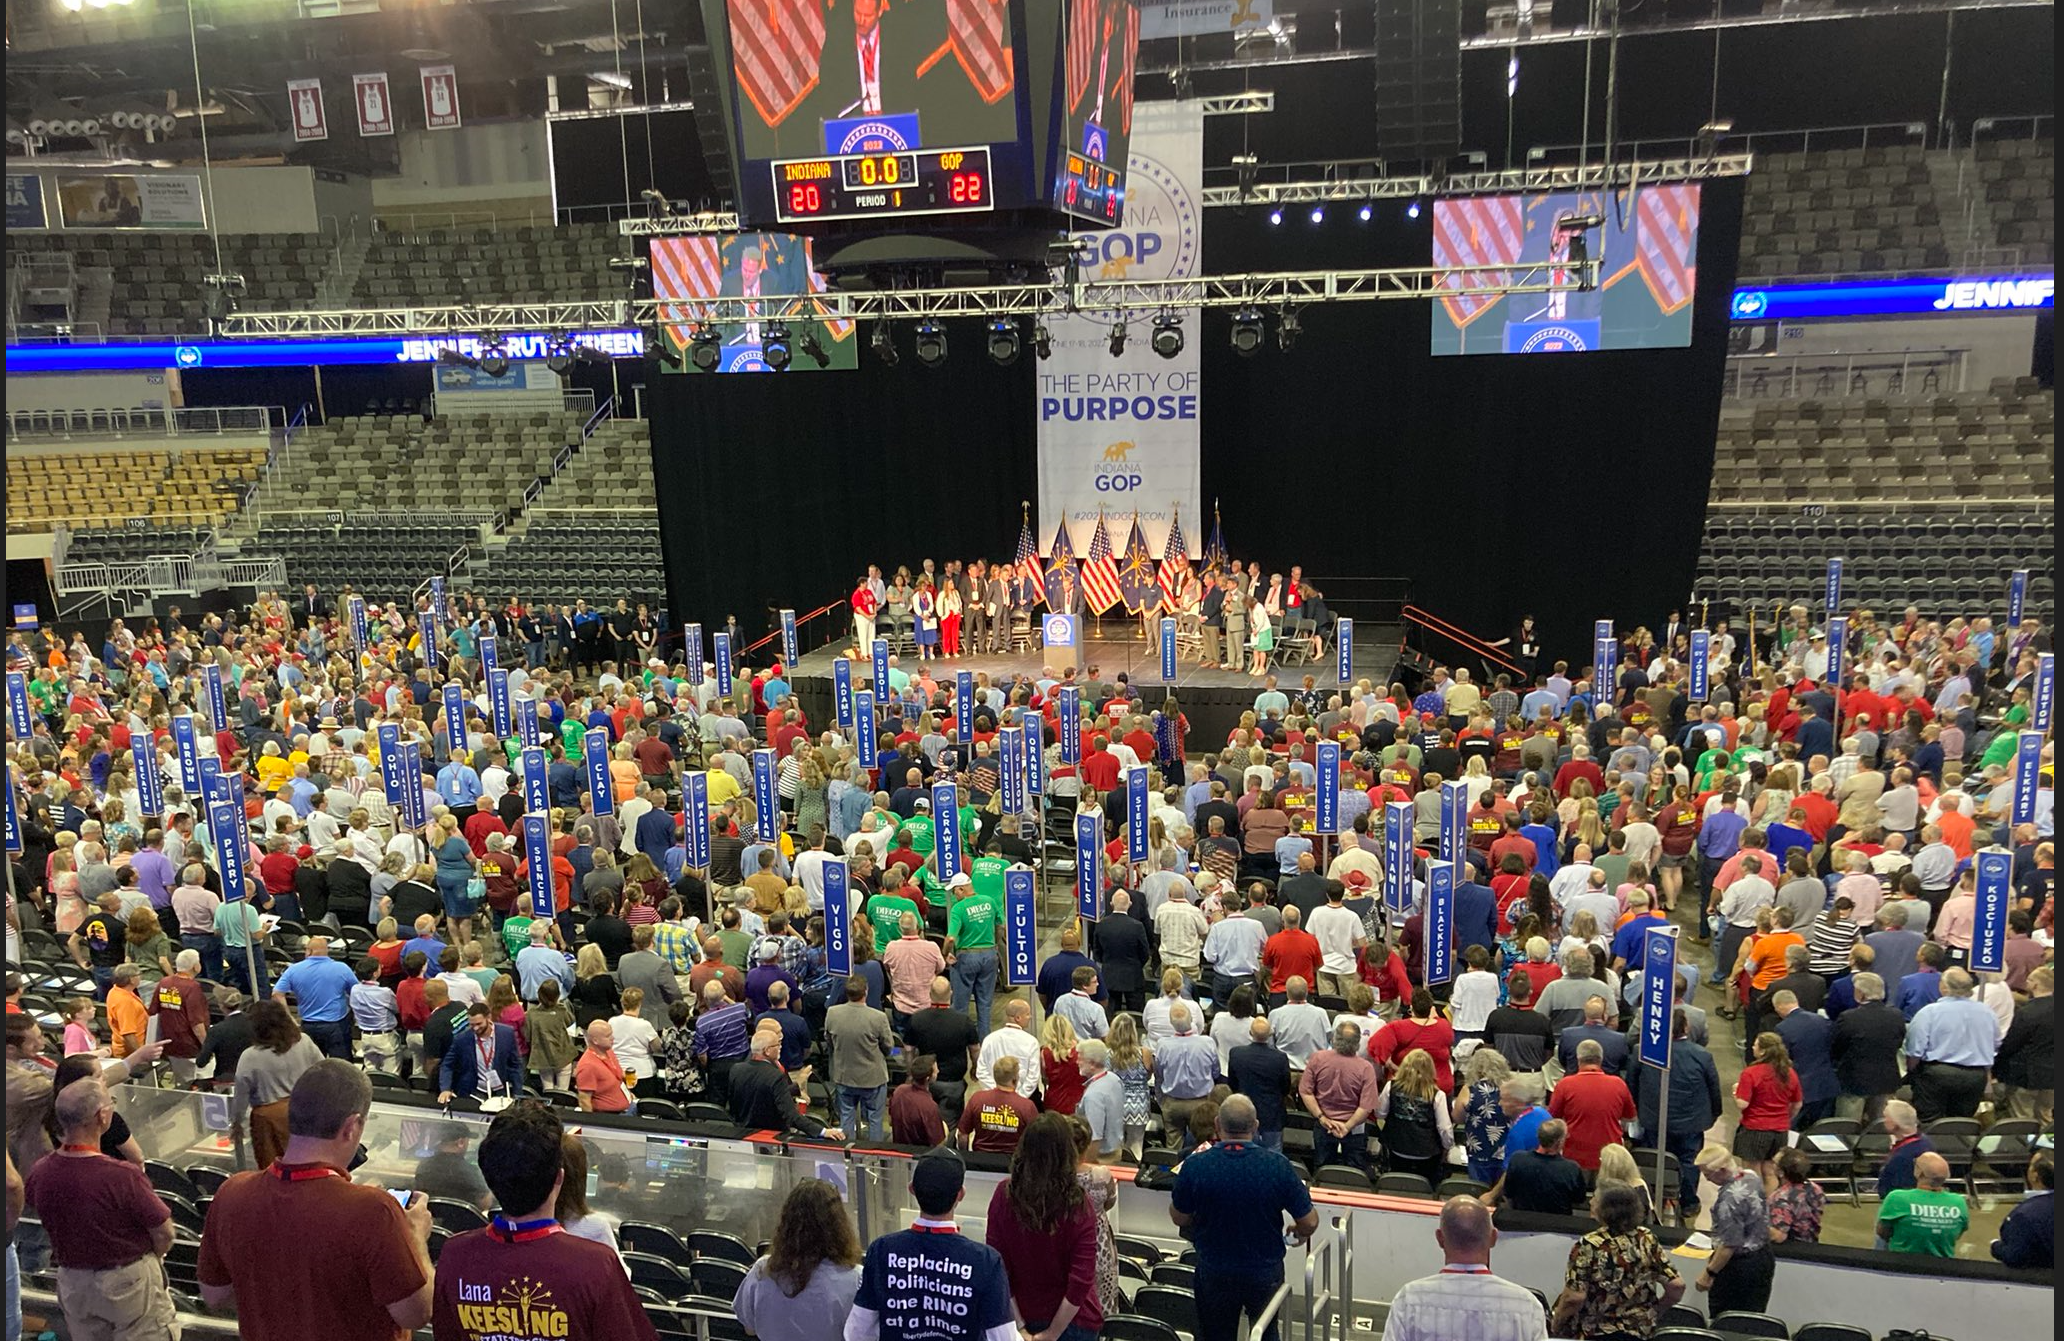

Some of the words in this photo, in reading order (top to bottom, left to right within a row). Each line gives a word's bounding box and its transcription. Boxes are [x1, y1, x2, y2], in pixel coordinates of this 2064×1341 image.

[1164, 4, 1231, 19] Insurance
[786, 163, 831, 181] INDIANA
[940, 153, 964, 170] GOP
[791, 184, 820, 212] 20
[856, 194, 886, 207] PERIOD
[952, 173, 981, 202] 22
[1078, 233, 1162, 267] GOP
[508, 335, 560, 358] RUT
[1040, 374, 1080, 393] THE
[1087, 373, 1160, 392] PARTY
[1167, 372, 1197, 391] OF
[1042, 395, 1196, 421] PURPOSE
[1094, 463, 1142, 473] INDIANA
[1095, 475, 1142, 491] GOP
[129, 519, 146, 528] 106
[327, 514, 340, 522] 107
[1803, 506, 1823, 517] 110
[720, 651, 728, 693] DEARBORN
[1830, 644, 1838, 672] CASS
[1695, 659, 1704, 693] JOSEPH
[15, 693, 28, 733] JOHNSON
[498, 688, 507, 736] FRANKLIN
[840, 682, 849, 717] ADAMS
[2038, 677, 2052, 726] BENTON
[862, 716, 870, 762] DAVIESS
[183, 742, 195, 783] BROWN
[387, 755, 399, 788] OHIO
[1029, 738, 1038, 788] ORANGE
[138, 759, 150, 808] DECATUR
[151, 758, 161, 805] DECATUR
[412, 769, 422, 819] FAYETTE
[532, 780, 543, 813] PARK
[595, 764, 606, 798] CLAY
[1003, 754, 1011, 808] GIBSON
[2020, 762, 2033, 818] ELKHART
[760, 775, 770, 838] SULLIVAN
[237, 806, 247, 853] SCOTT
[698, 802, 707, 858] WARRICK
[905, 822, 928, 831] DIEGO
[942, 810, 954, 877] CRAWFORD
[223, 838, 238, 889] PERRY
[534, 847, 545, 907] SPENCER
[977, 861, 1001, 870] DIEGO
[1082, 850, 1092, 903] WELLS
[1389, 840, 1397, 894] MIAMI
[876, 906, 901, 918] DIEGO
[966, 903, 992, 916] DIEGO
[1982, 886, 1998, 964] KOSCIUSKO
[831, 904, 842, 951] VIGO
[1016, 905, 1028, 975] FULTON
[1436, 898, 1445, 975] BLACKFORD
[1651, 977, 1664, 1045] HENRY
[981, 1112, 1019, 1127] KEESLING
[983, 1104, 995, 1112] Lana
[1910, 1203, 1961, 1219] DIEGO
[888, 1252, 972, 1280] Replacing
[459, 1278, 491, 1301] Lana
[887, 1274, 973, 1298] Politicians
[457, 1303, 569, 1337] KEESLING
[887, 1297, 918, 1310] one
[923, 1295, 968, 1316] RINO
[886, 1315, 903, 1327] at
[909, 1317, 919, 1328] a
[925, 1315, 967, 1334] time.
